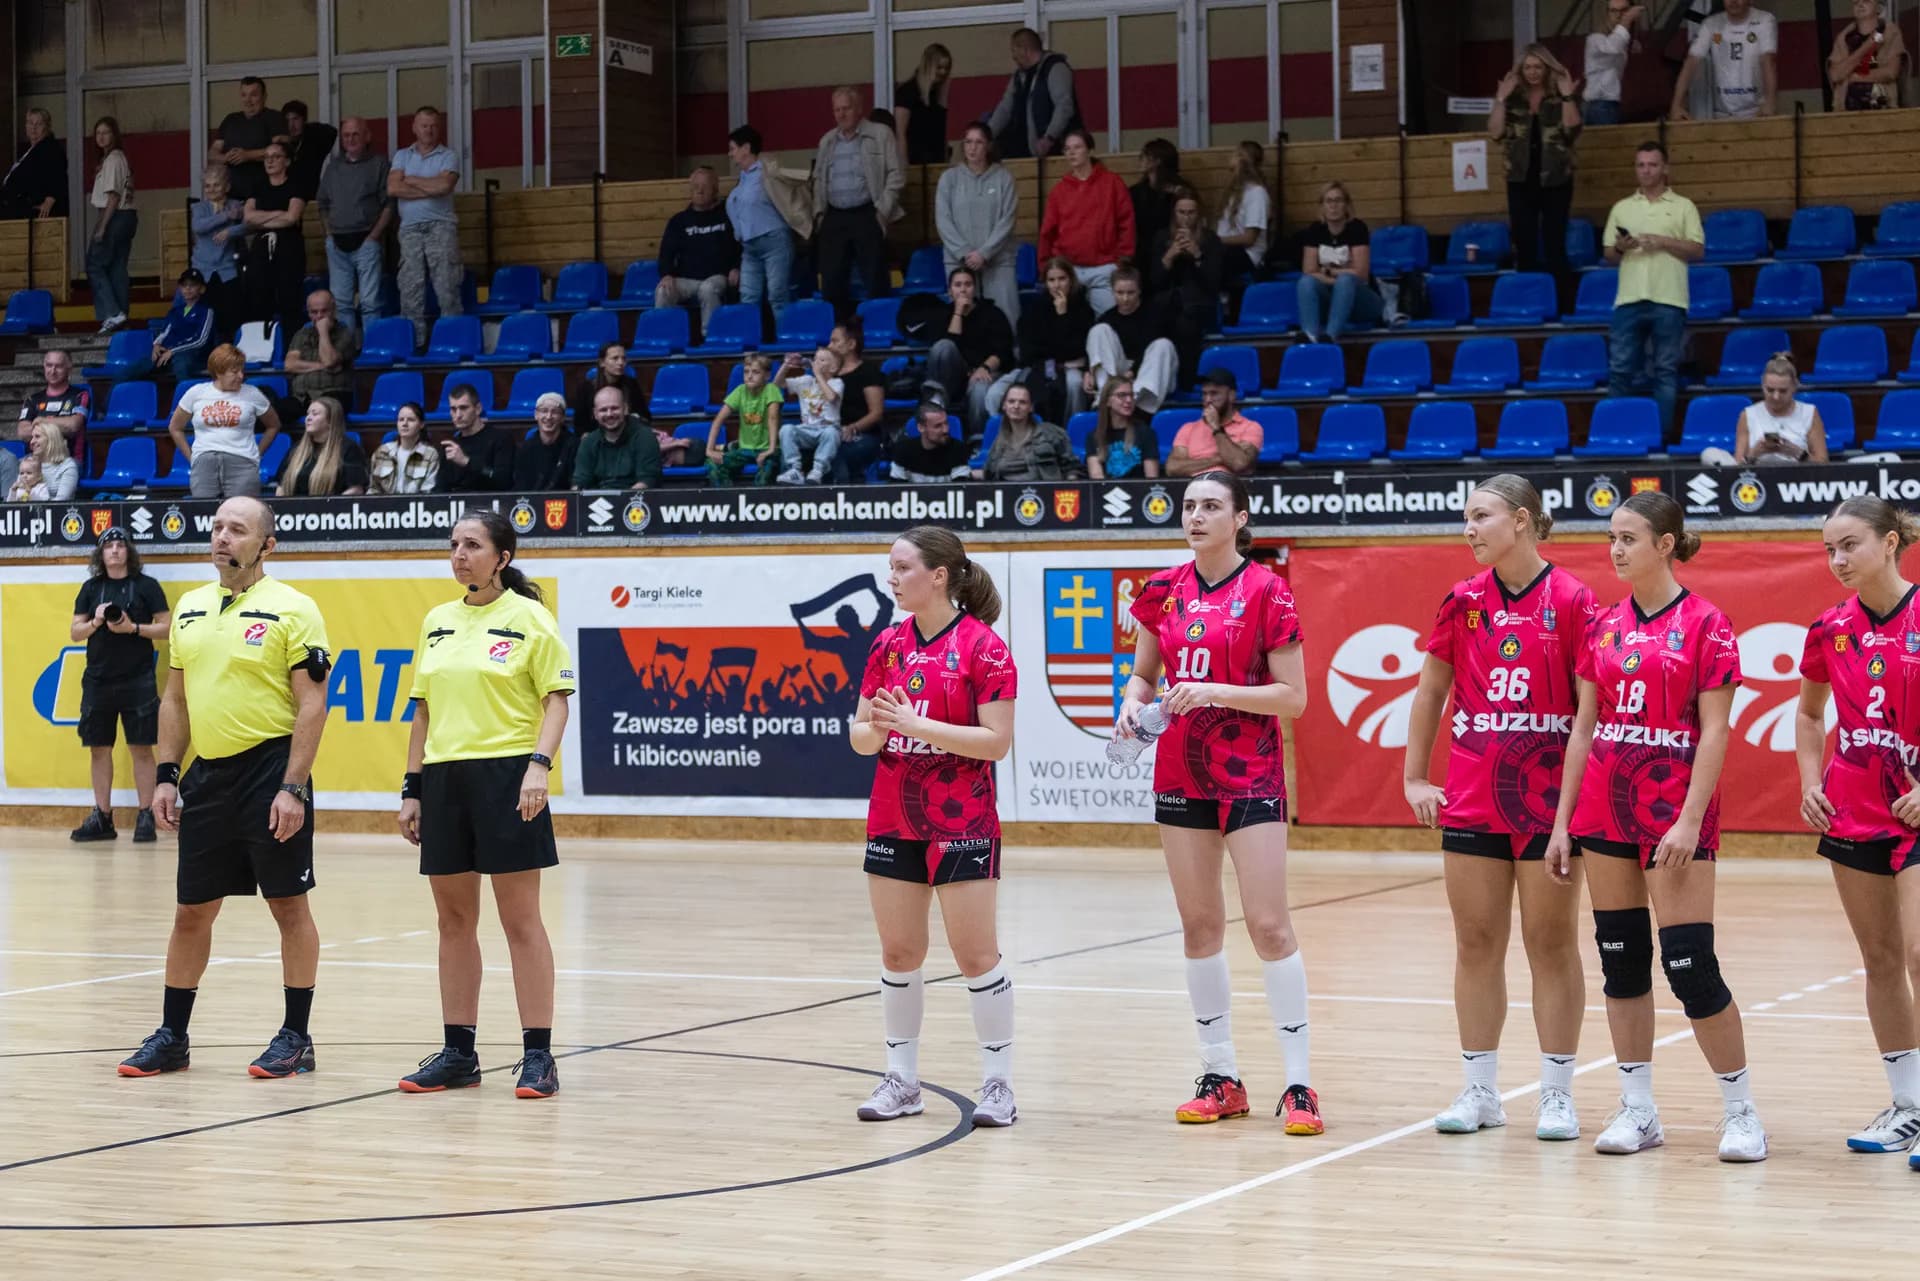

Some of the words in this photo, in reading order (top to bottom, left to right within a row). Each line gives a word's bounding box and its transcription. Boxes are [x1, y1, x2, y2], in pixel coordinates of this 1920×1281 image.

[608, 50, 624, 66] A
[1730, 42, 1743, 60] 12
[1463, 163, 1477, 180] A
[659, 490, 1003, 528] www.koronahandball.pl
[634, 587, 662, 601] Targi
[666, 586, 703, 598] Kielce
[1176, 647, 1211, 679] 10
[1487, 667, 1531, 701] 36
[1616, 680, 1647, 713] 18
[1866, 686, 1886, 718] 2
[612, 711, 698, 734] Zawsze
[703, 712, 747, 739] jest
[752, 714, 806, 739] pora
[811, 717, 841, 735] na
[1600, 723, 1690, 748] SUZUKI
[613, 744, 620, 765] i
[626, 744, 761, 767] kibicowanie
[1159, 793, 1187, 805] Kielce
[868, 842, 895, 855] Kielce
[1670, 957, 1692, 968] SELECT
